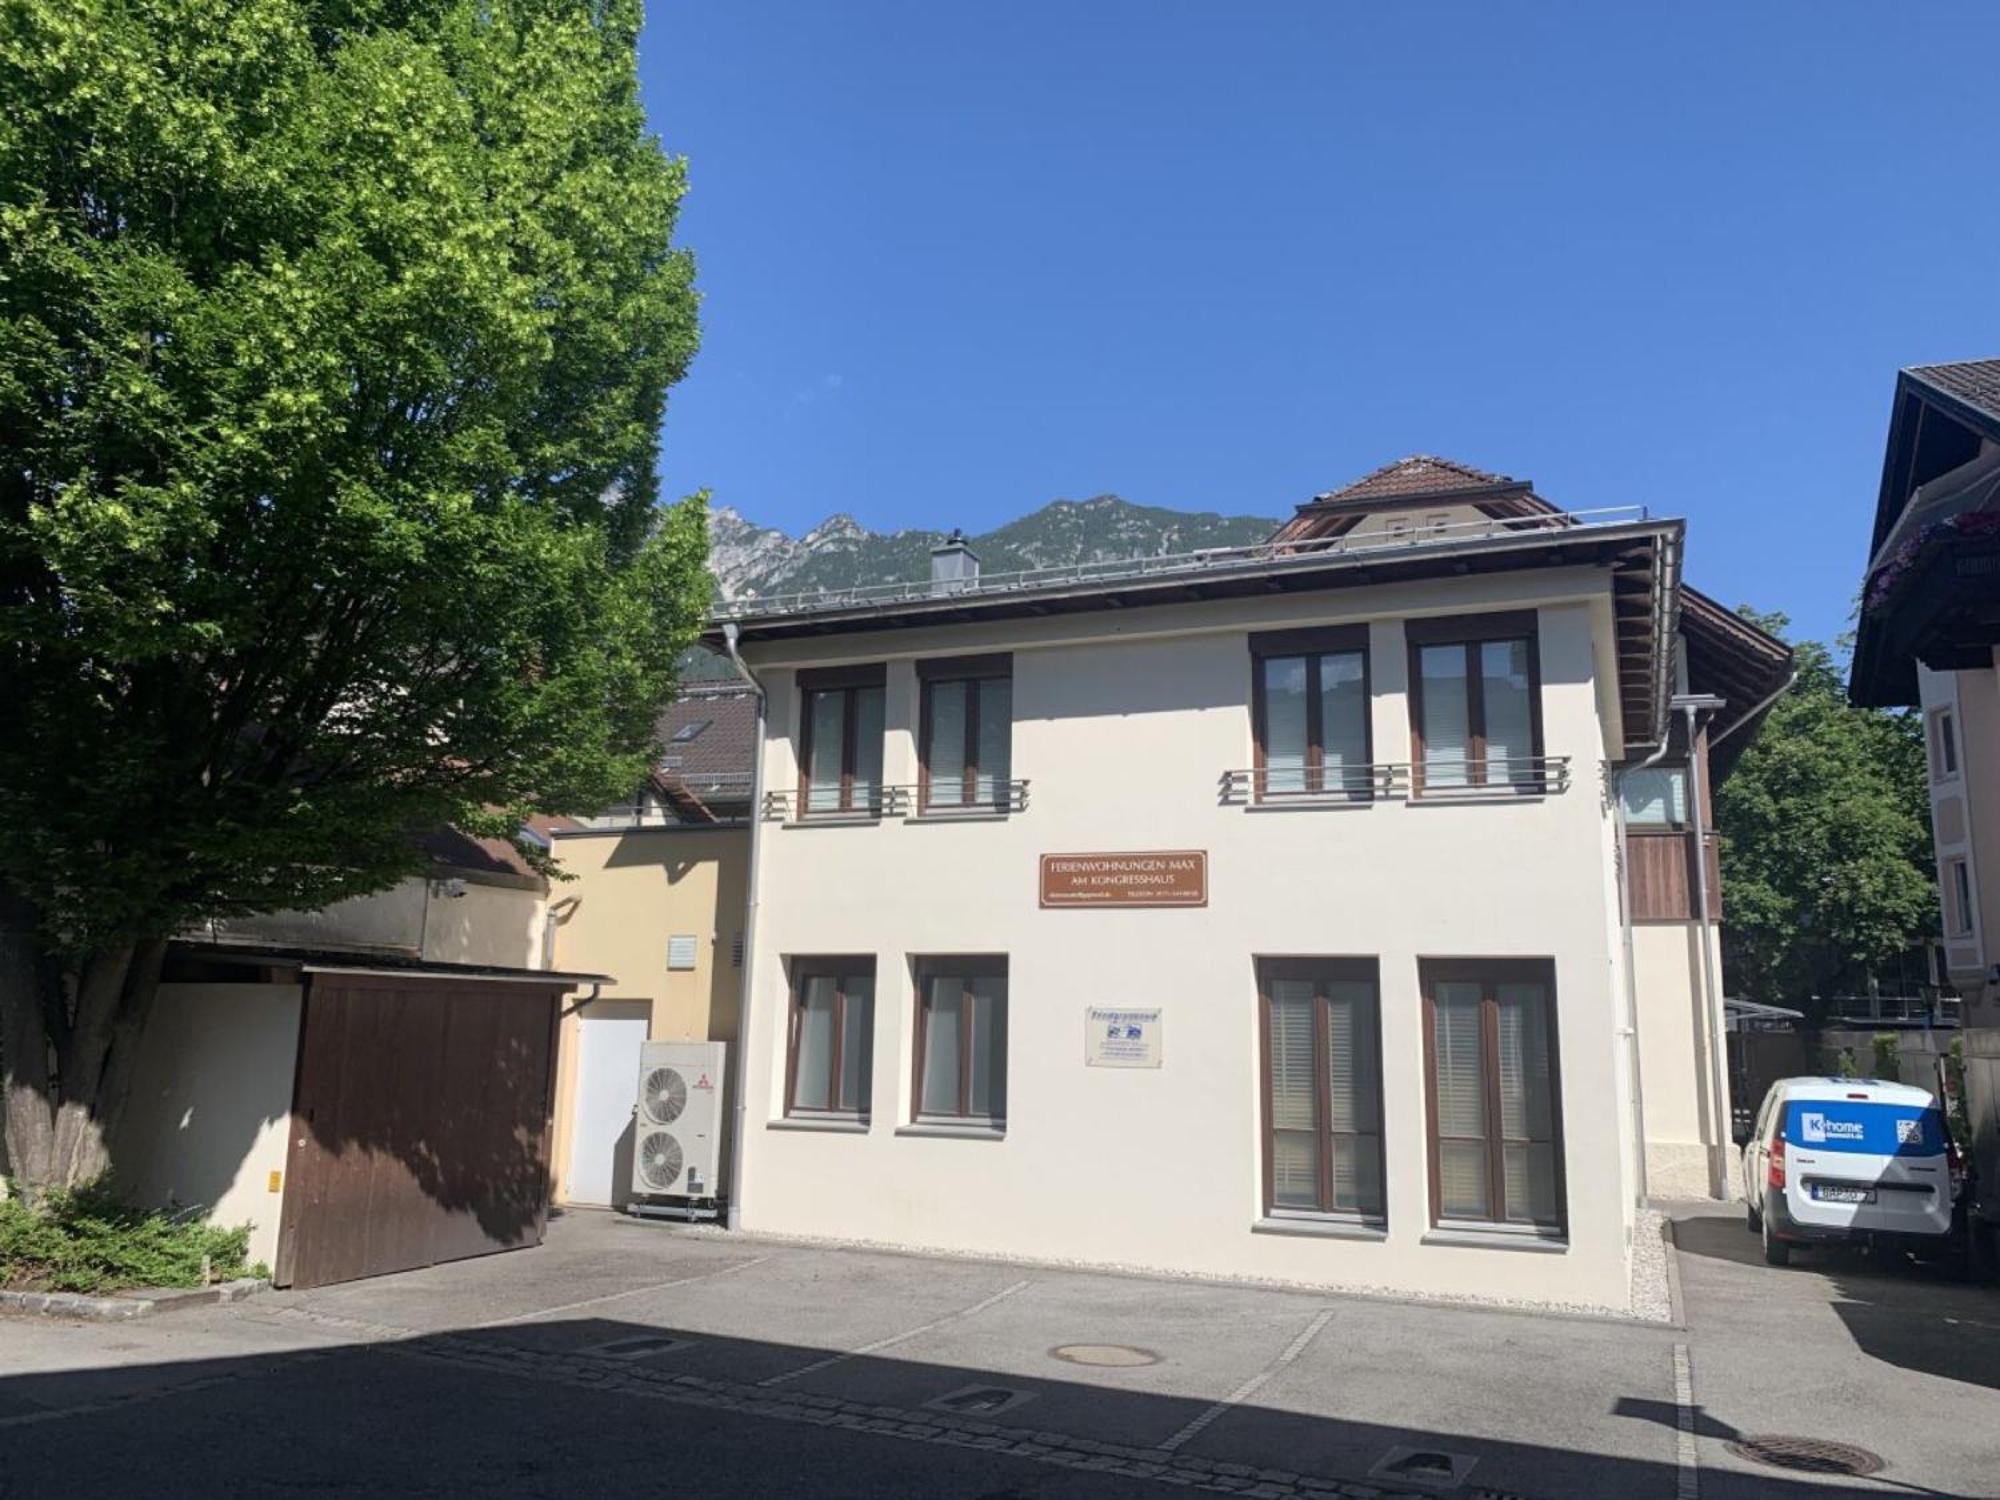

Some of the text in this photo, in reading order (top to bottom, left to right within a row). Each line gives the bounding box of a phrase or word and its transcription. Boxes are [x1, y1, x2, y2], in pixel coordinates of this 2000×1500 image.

[1051, 859, 1196, 873] FERIENWOHNUNGEN MAX
[1071, 874, 1175, 886] AM KONGRESSHAUS
